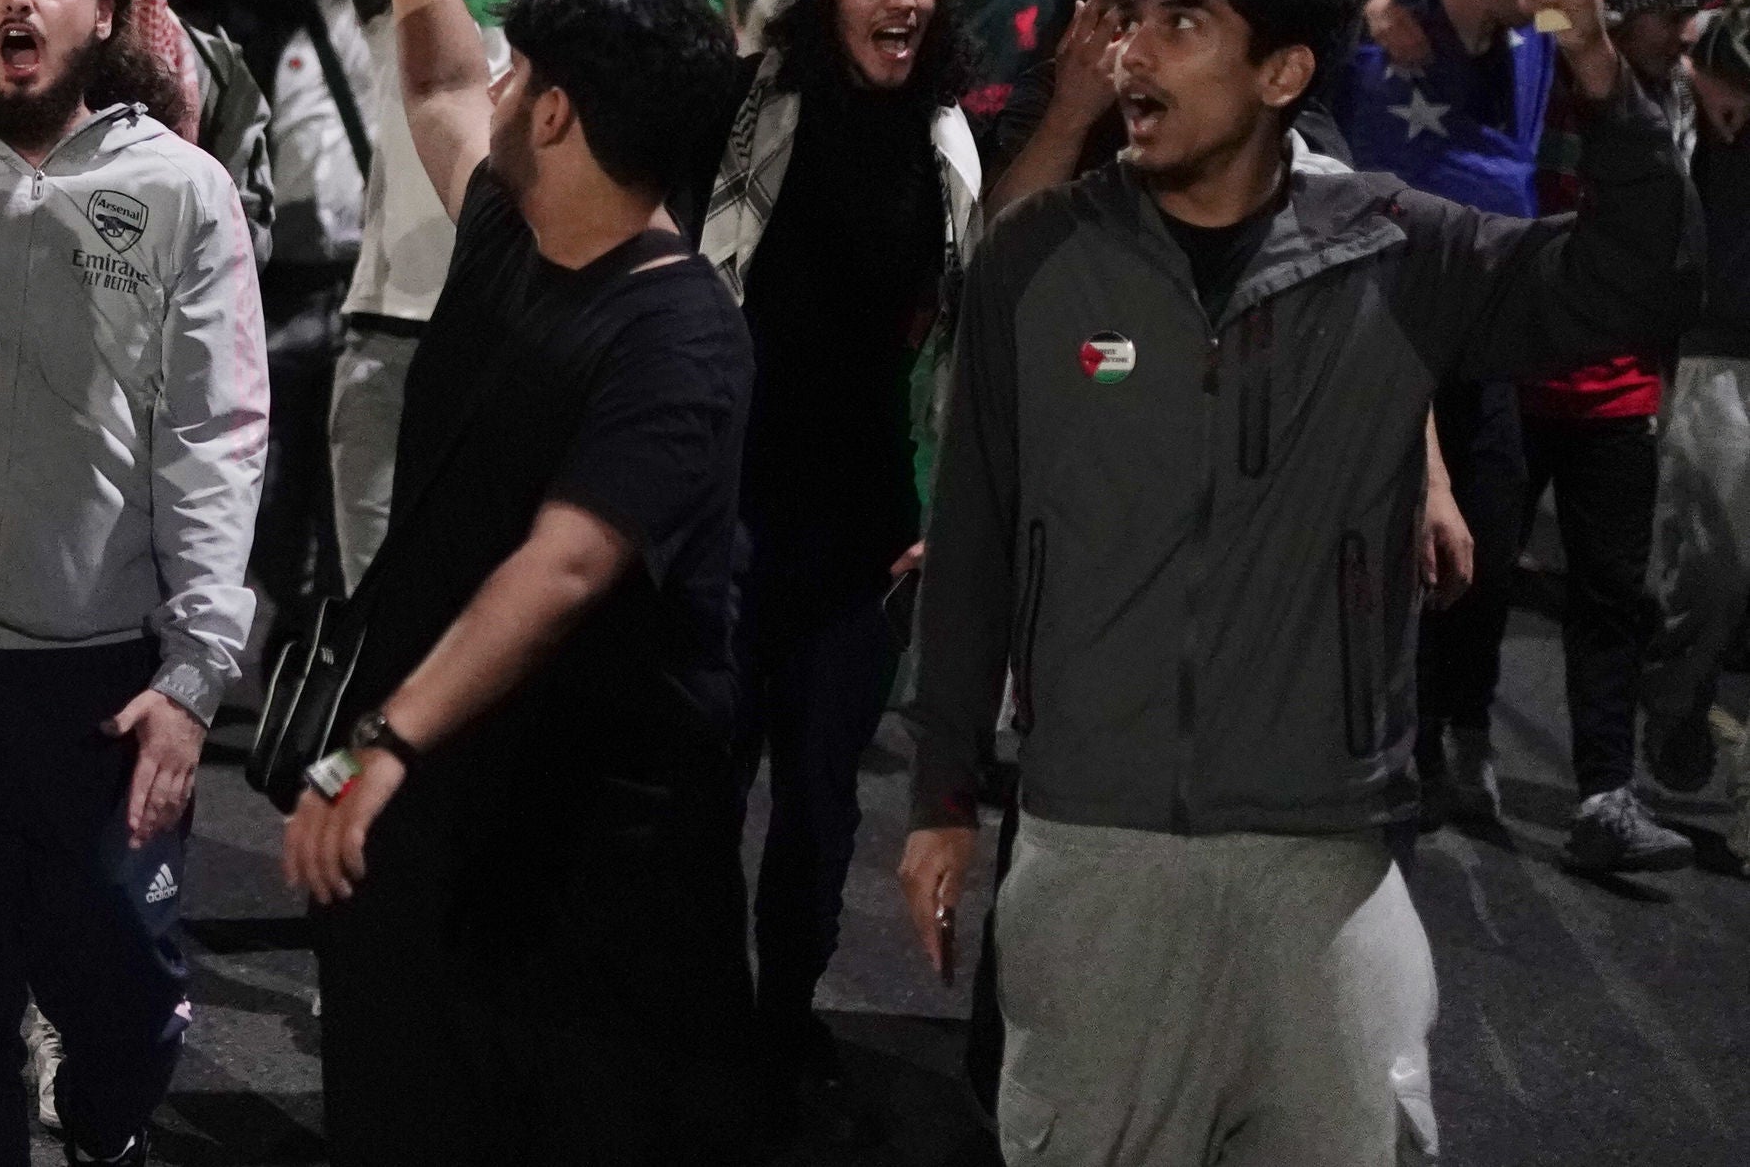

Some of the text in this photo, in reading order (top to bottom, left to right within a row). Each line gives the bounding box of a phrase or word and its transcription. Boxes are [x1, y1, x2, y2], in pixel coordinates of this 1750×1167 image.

[97, 198, 140, 221] Arsenal
[81, 270, 139, 295] FLY BETTER
